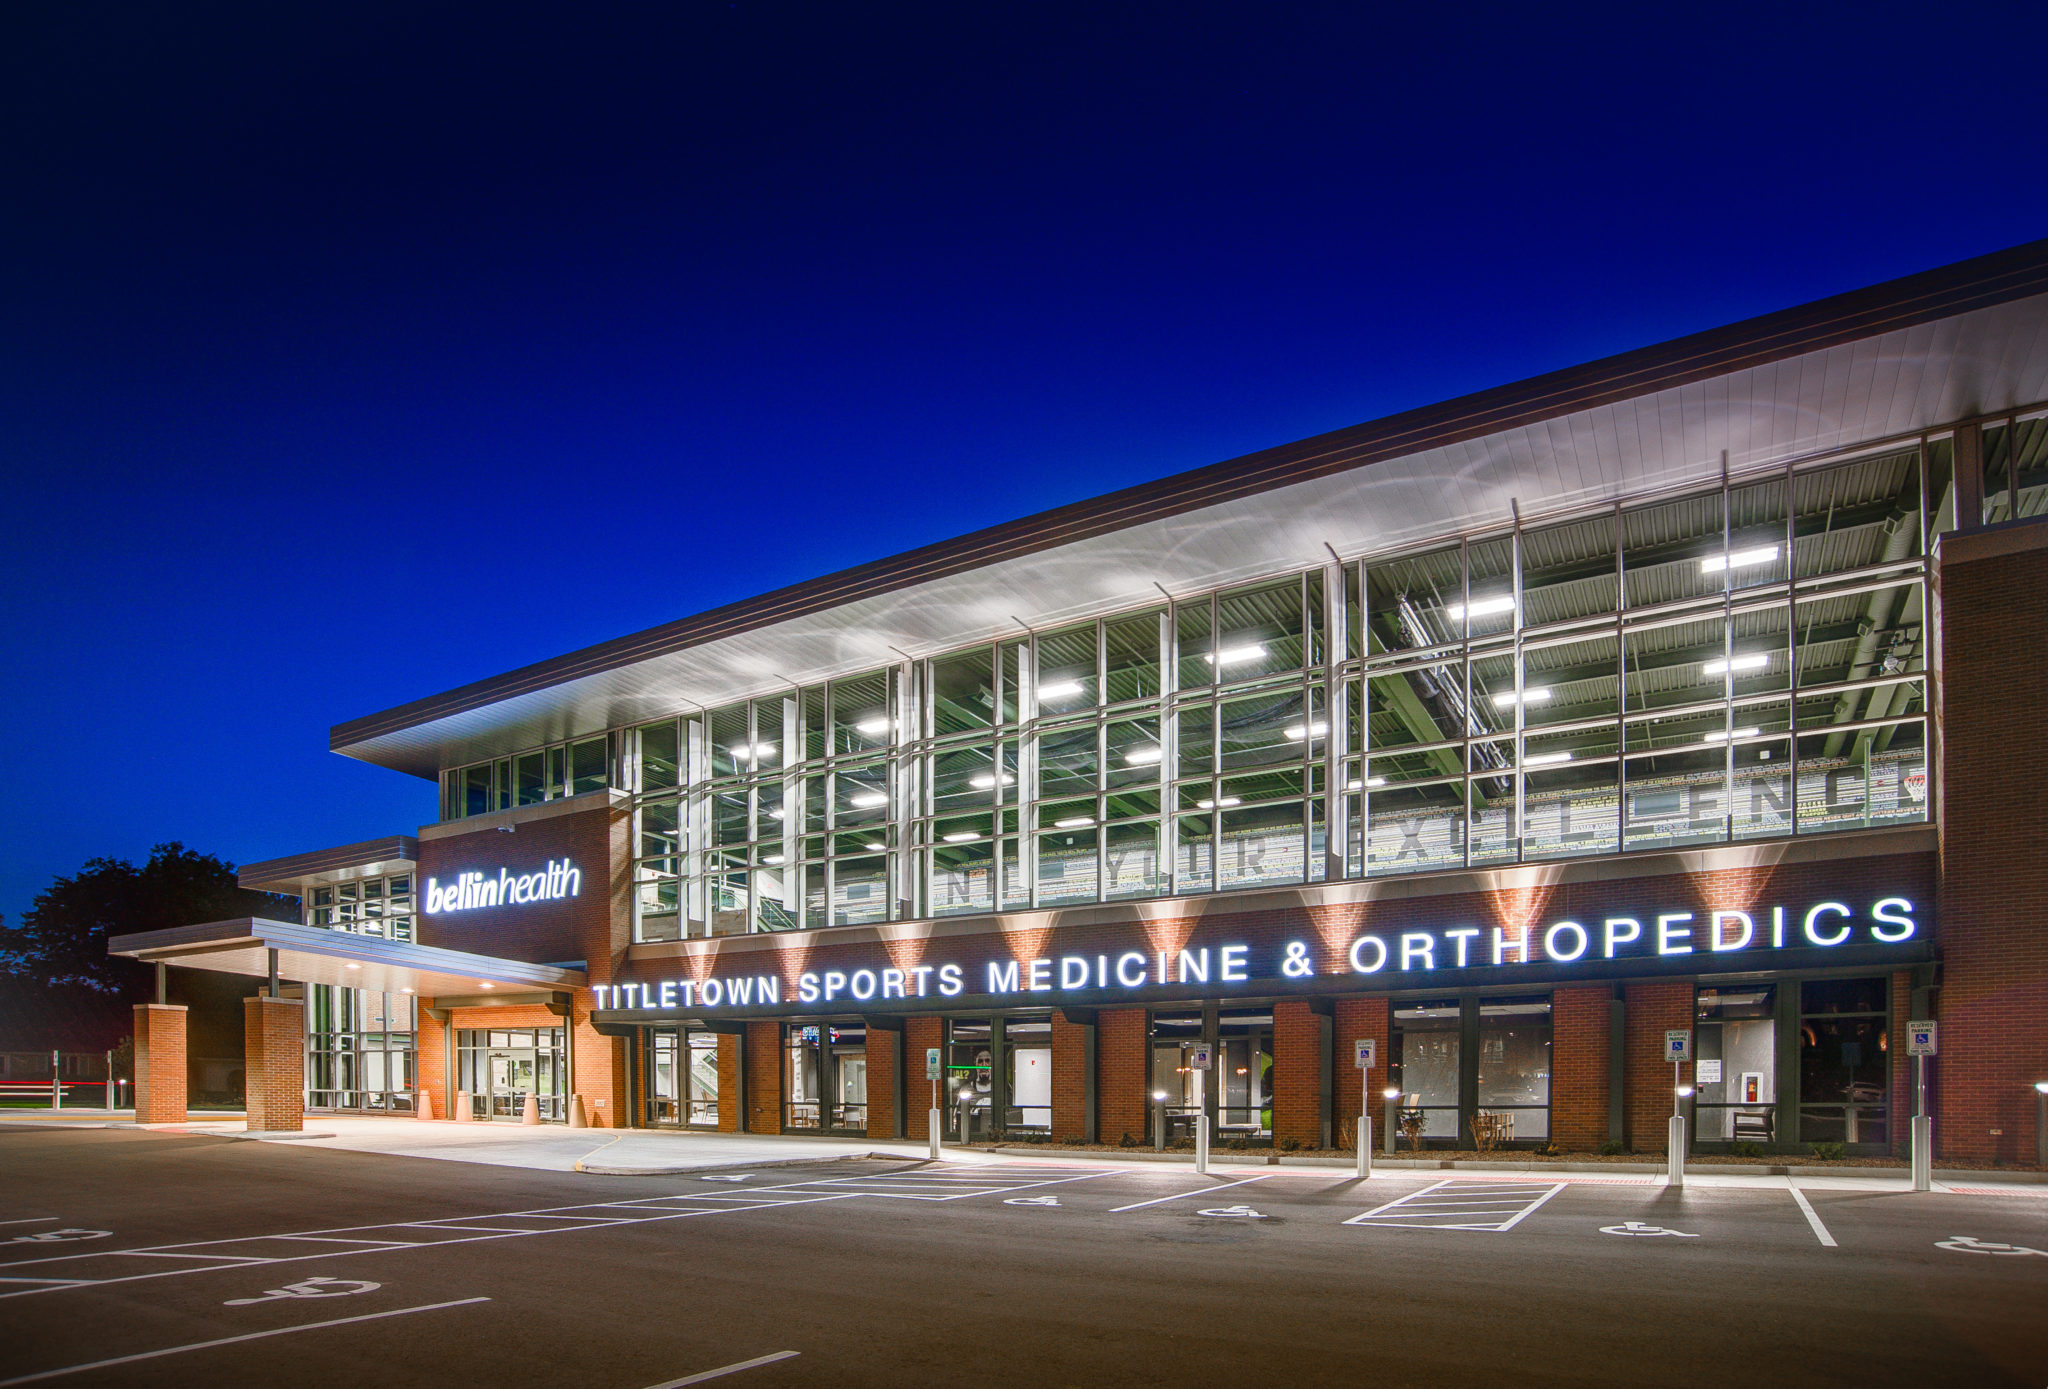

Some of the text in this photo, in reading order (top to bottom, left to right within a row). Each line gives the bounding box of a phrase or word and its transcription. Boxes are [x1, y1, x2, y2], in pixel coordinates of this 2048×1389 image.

[592, 897, 1916, 1010] TITLETOWN SPORTS MEDICINE & ORTHOPEDICS
